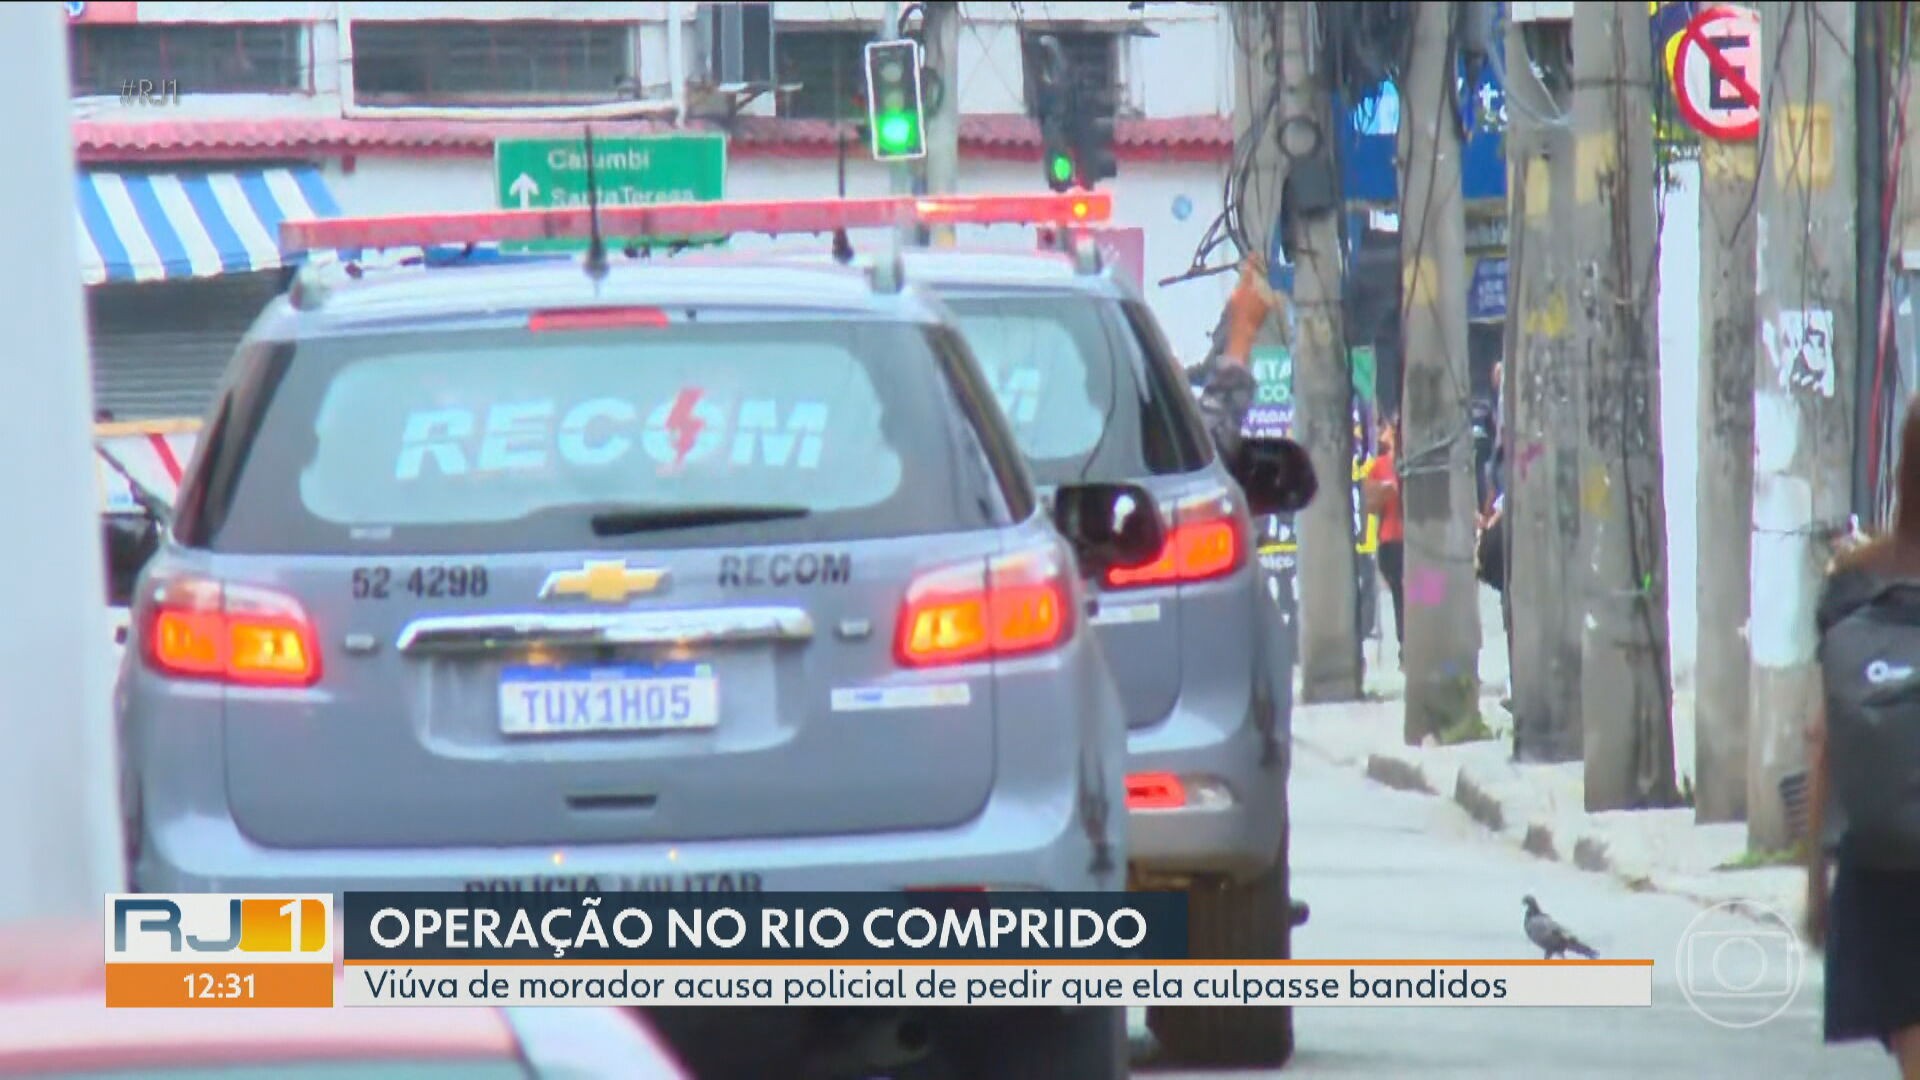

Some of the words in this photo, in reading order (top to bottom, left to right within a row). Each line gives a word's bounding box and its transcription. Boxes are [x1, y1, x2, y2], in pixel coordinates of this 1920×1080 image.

[1705, 34, 1751, 109] E
[395, 390, 829, 480] RECOM
[352, 567, 390, 599] 52
[406, 565, 489, 598] 4298
[717, 553, 852, 588] RECOM
[521, 684, 692, 725] TUX1H05
